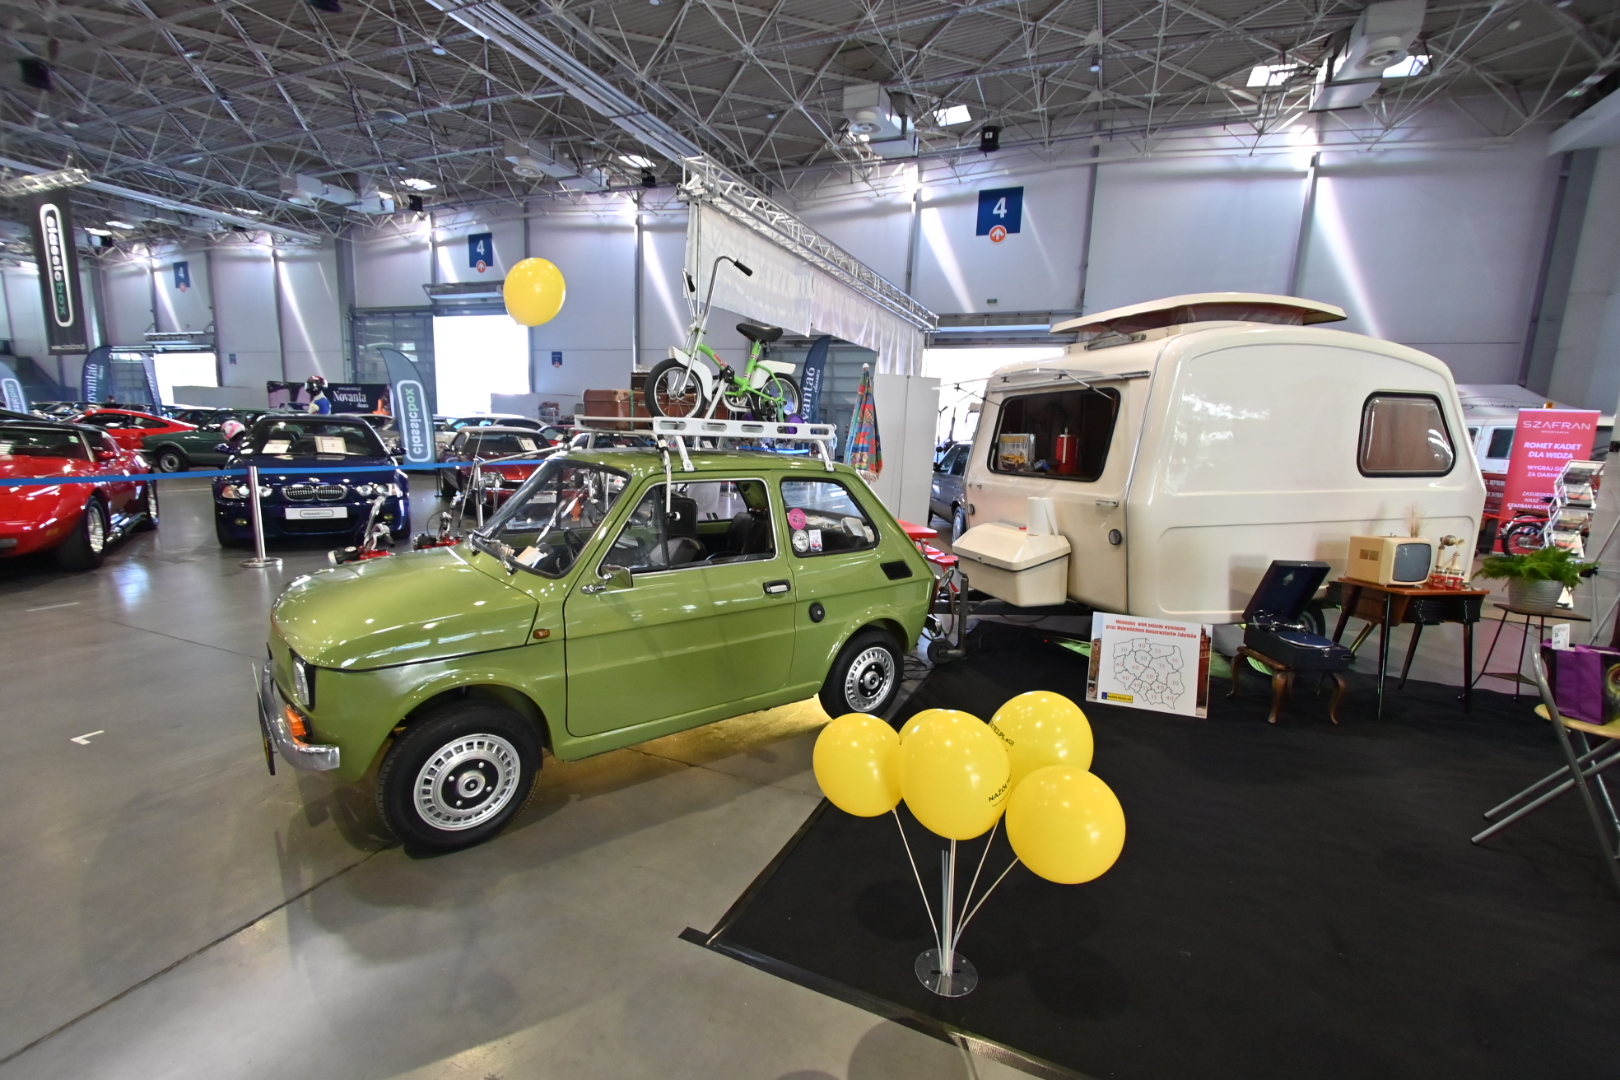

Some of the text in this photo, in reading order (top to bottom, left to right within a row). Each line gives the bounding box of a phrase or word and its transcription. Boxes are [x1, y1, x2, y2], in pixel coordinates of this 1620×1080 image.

[993, 197, 1007, 218] 4
[476, 240, 485, 255] 4
[46, 216, 66, 315] classicbox
[178, 267, 185, 279] 4
[87, 364, 99, 403] ovanta6
[333, 391, 367, 402] Novanta
[1523, 421, 1591, 430] SZAFRAN
